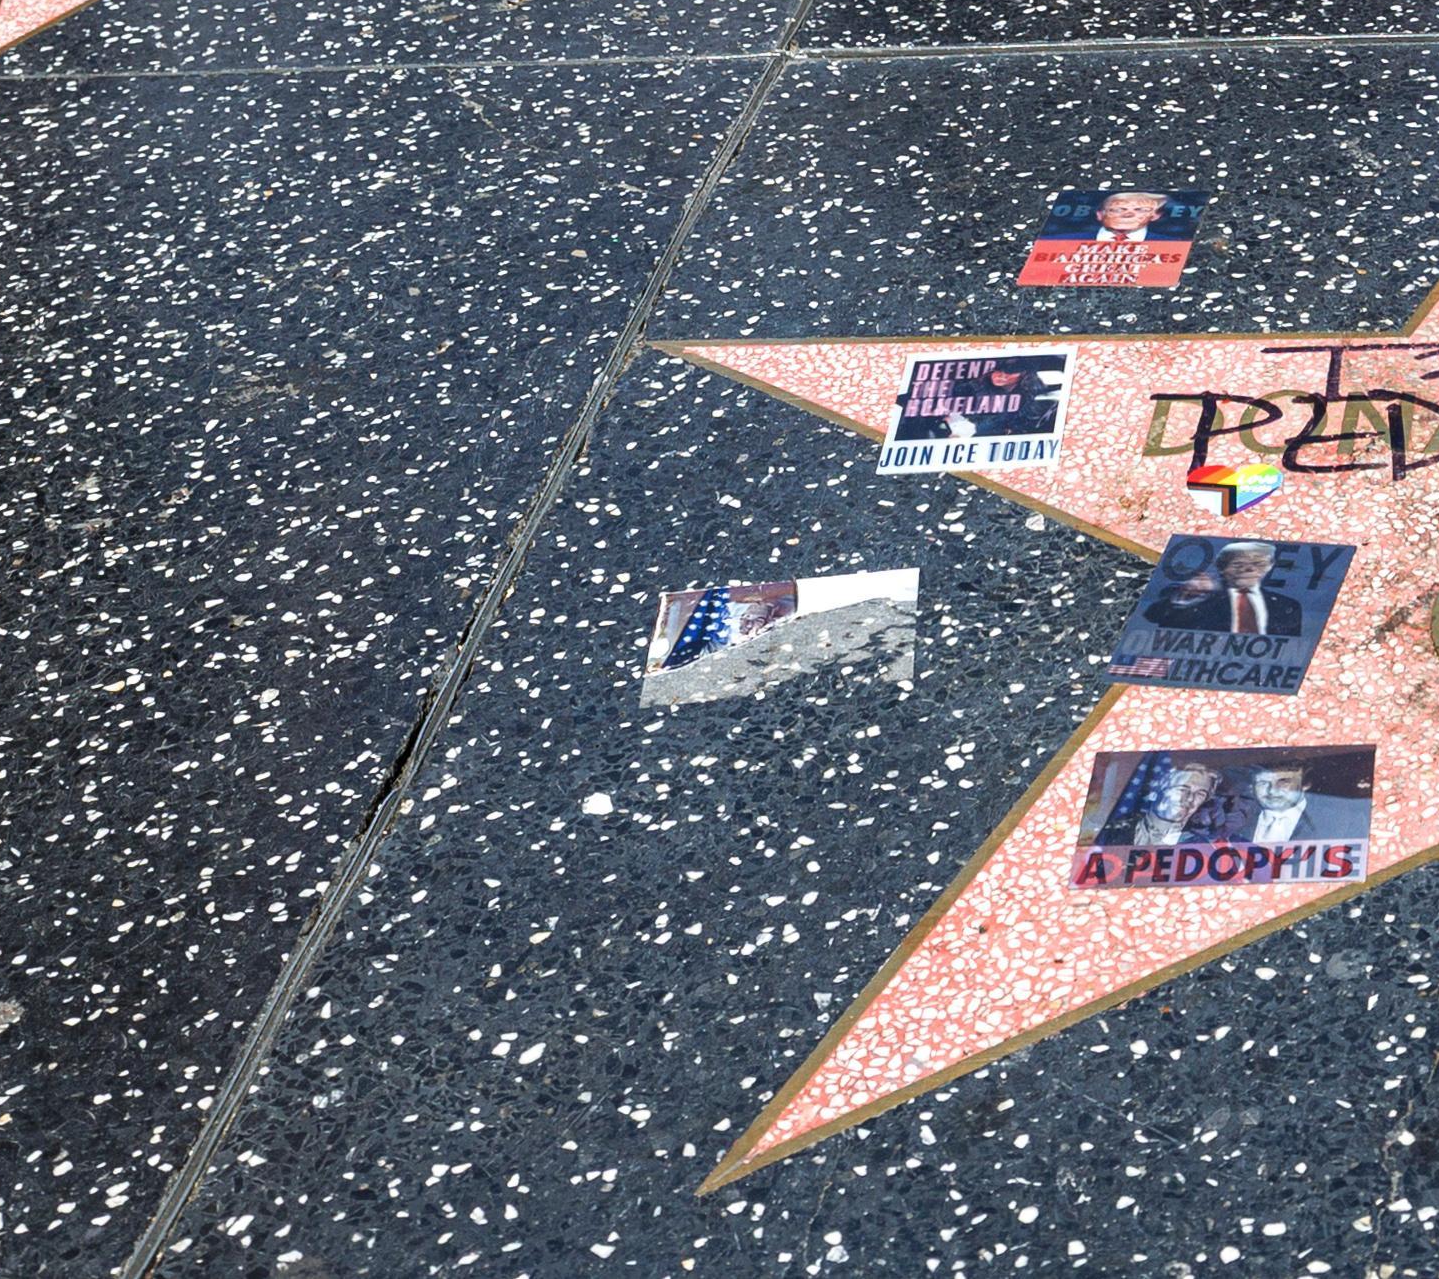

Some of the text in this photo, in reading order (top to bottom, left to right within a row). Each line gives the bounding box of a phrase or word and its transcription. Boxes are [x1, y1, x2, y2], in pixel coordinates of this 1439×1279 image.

[1076, 244, 1149, 254] MAKE
[1052, 253, 1162, 264] AMERICA
[1064, 263, 1147, 274] GREAT
[1062, 273, 1139, 283] AGAIN
[916, 360, 997, 381] DEFEND
[912, 380, 953, 398] THE
[905, 394, 1021, 418] HOMELAND
[880, 439, 1059, 468] JOIN ICE TODAY
[1151, 629, 1290, 660] WAR NOT
